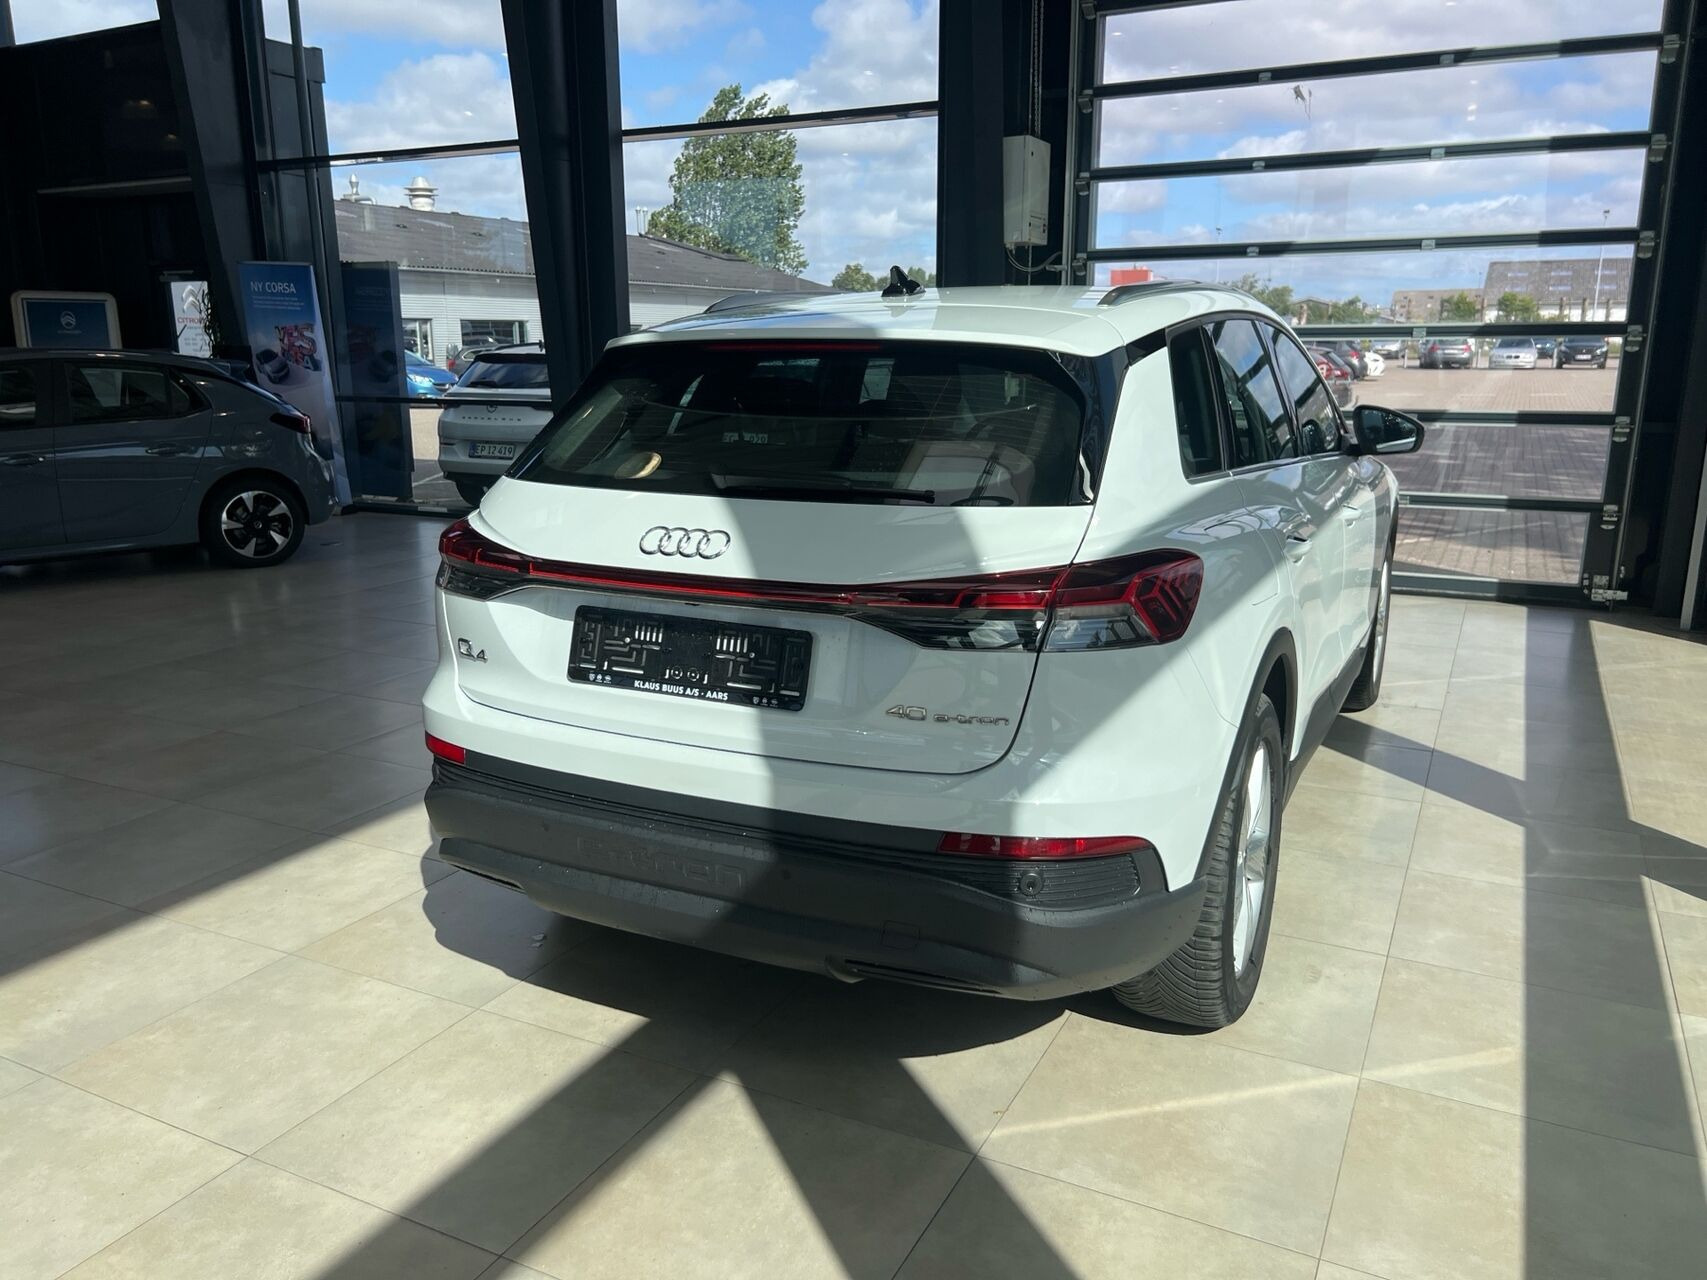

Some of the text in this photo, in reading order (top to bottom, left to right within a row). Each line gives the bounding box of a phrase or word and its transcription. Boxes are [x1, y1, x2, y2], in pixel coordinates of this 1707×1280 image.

[250, 281, 297, 294] NY CORSA
[458, 637, 488, 662] Q4
[634, 680, 729, 701] KLAUS BUUS A/S AARS
[887, 705, 1009, 726] 40 e-tron
